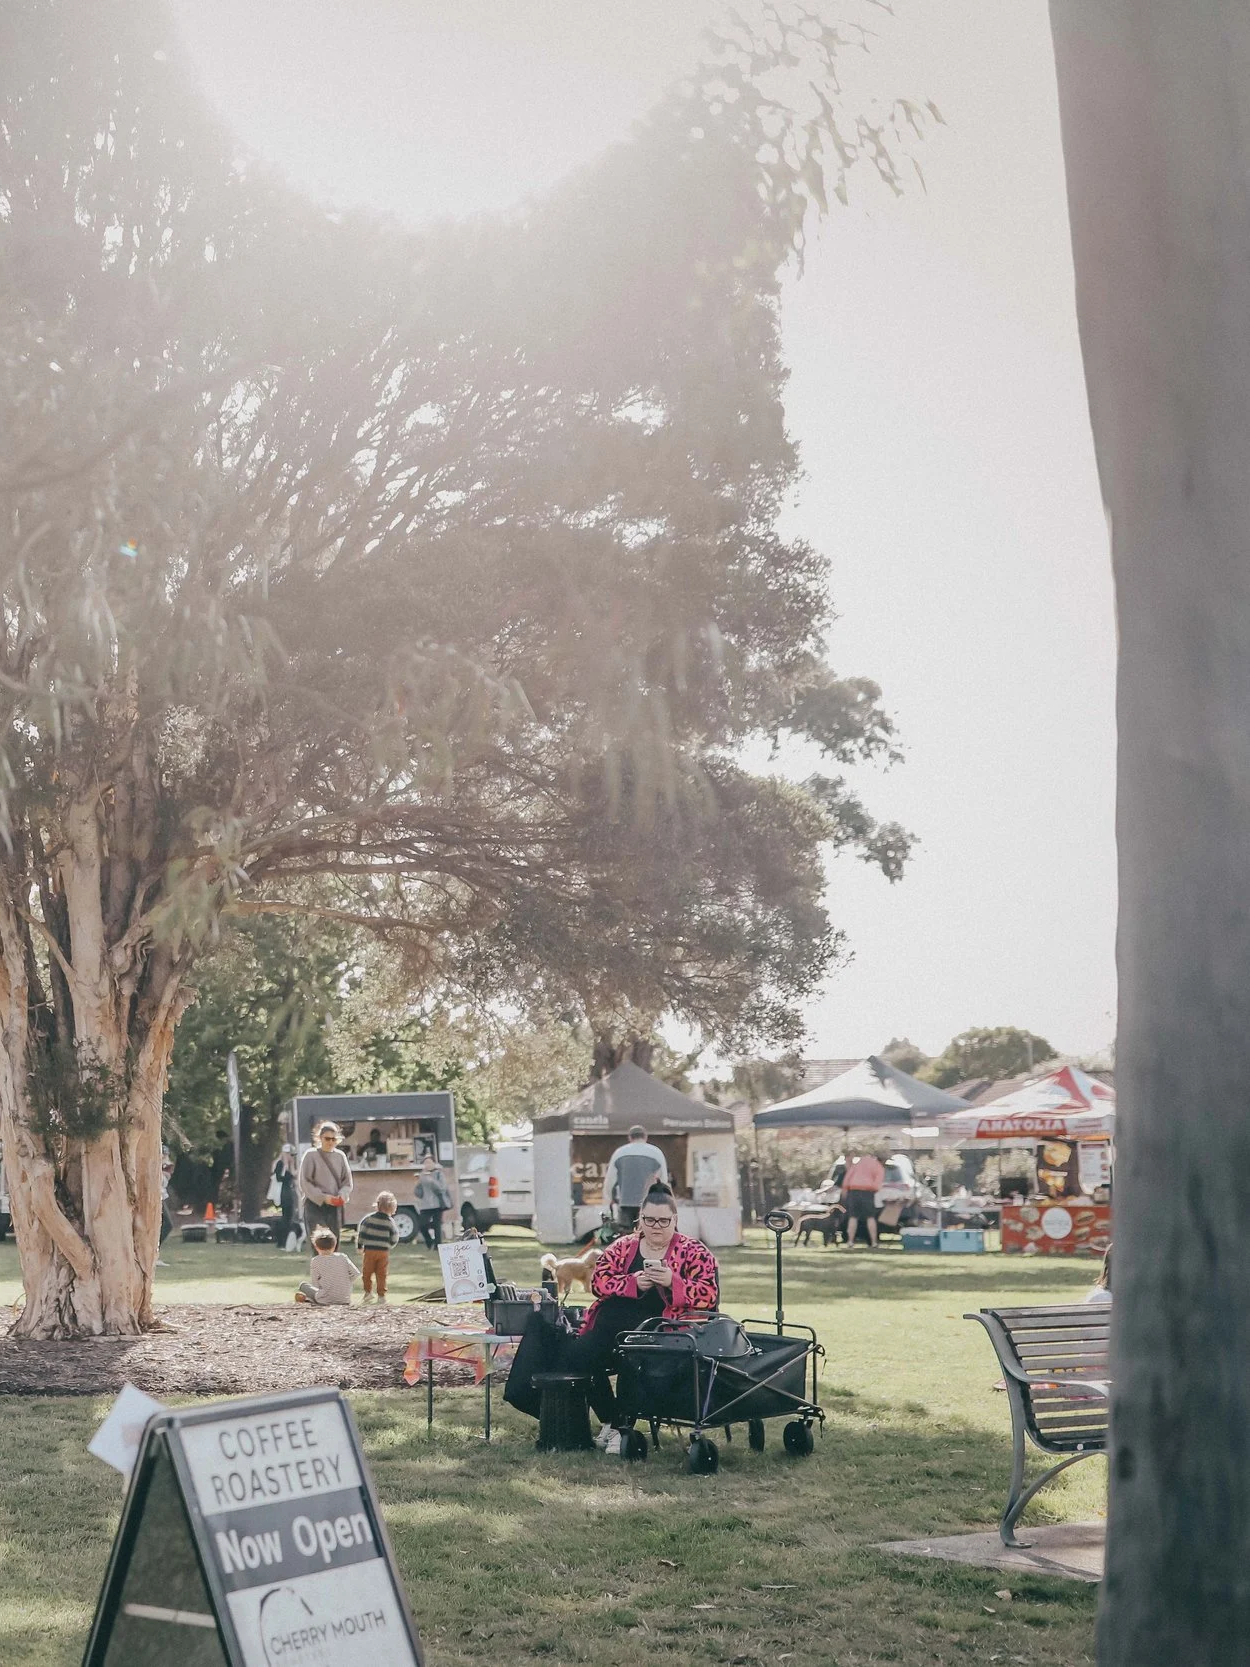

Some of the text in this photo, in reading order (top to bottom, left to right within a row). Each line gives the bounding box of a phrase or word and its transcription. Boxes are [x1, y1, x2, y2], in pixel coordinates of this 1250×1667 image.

[979, 1119, 1064, 1132] ANATOLIA
[218, 1418, 318, 1460] COFFEE
[211, 1454, 343, 1505] ROASTERY
[215, 1511, 374, 1574] Now Open
[270, 1609, 387, 1655] CHERRY MOUTH
